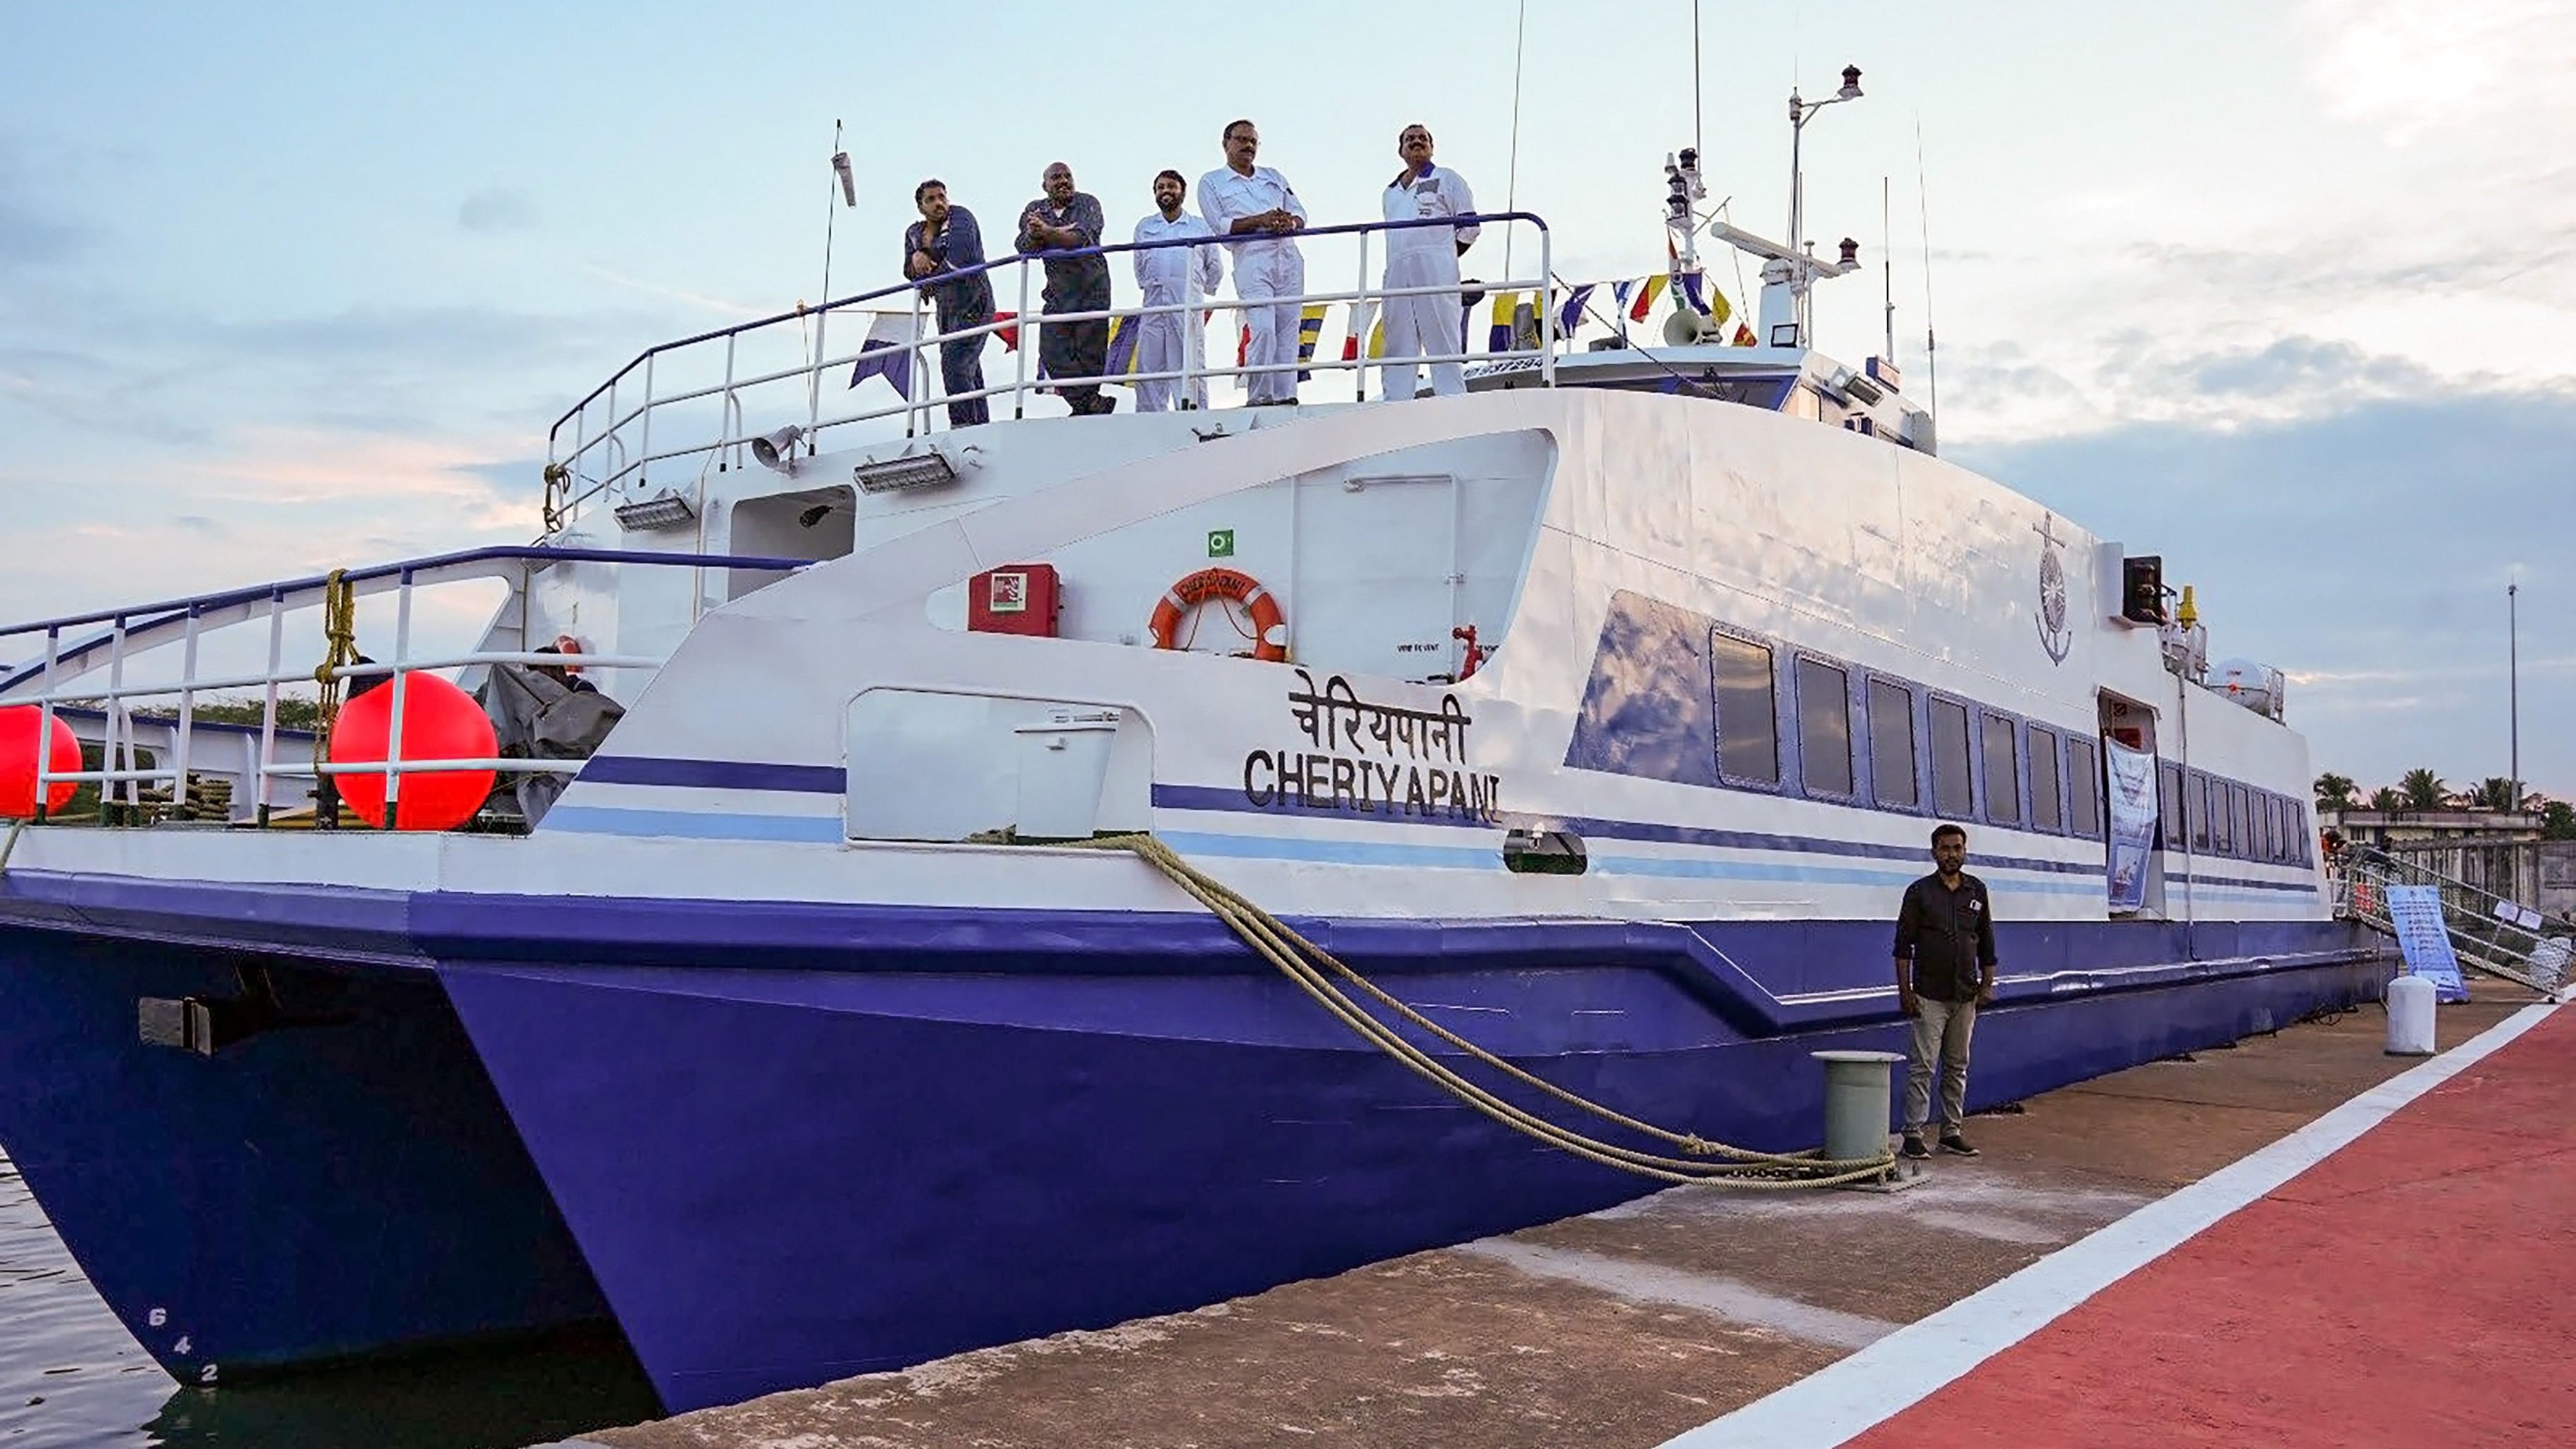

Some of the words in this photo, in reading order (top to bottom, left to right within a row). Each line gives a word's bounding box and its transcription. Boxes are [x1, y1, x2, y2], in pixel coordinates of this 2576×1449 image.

[1289, 669, 1472, 765] चेरियपानी
[1244, 750, 1503, 823] CHERIYAPANI
[149, 1308, 166, 1326] 6
[174, 1336, 191, 1354] 4
[202, 1364, 217, 1381] 2
